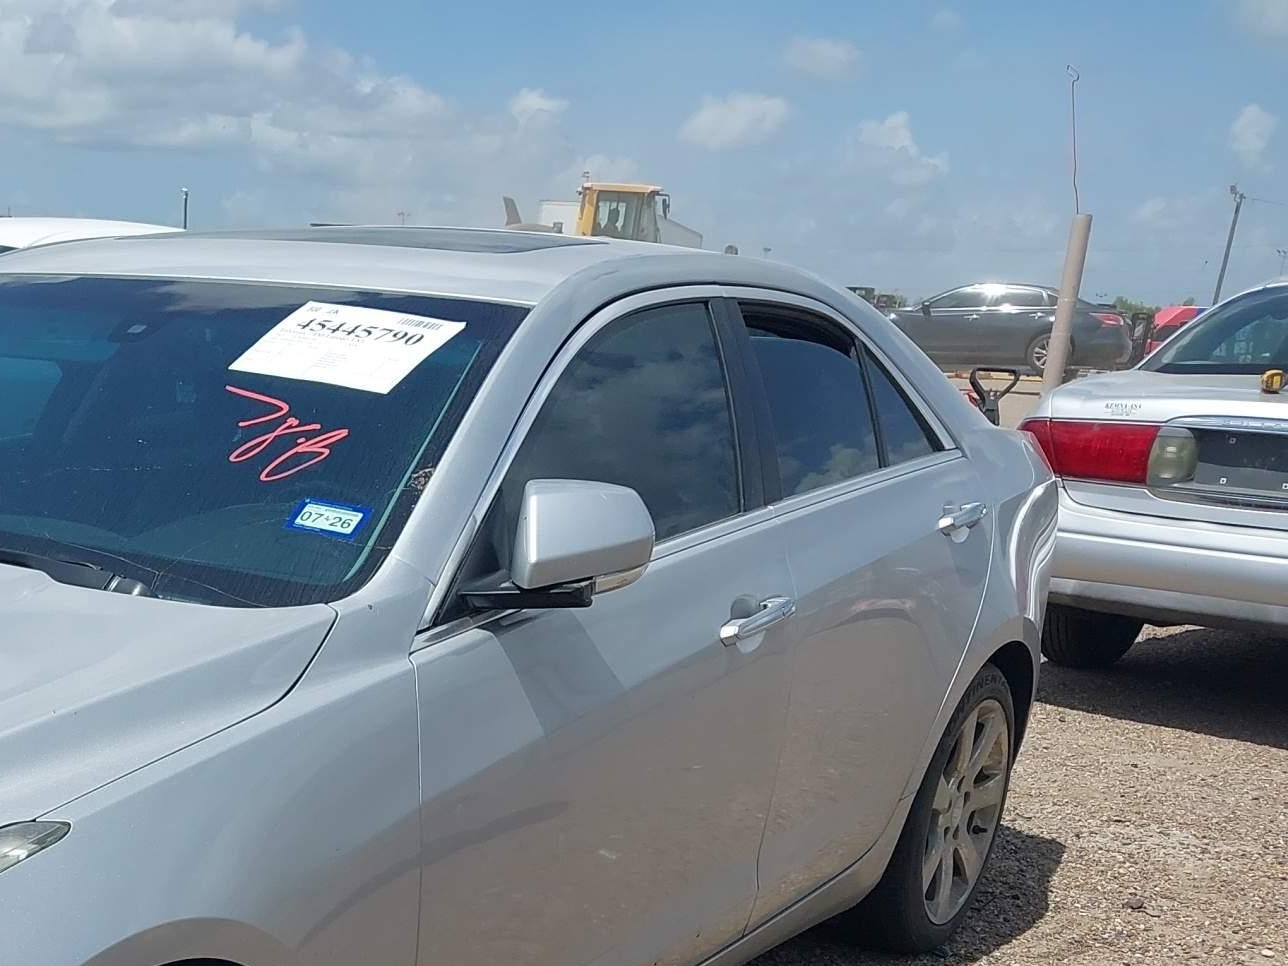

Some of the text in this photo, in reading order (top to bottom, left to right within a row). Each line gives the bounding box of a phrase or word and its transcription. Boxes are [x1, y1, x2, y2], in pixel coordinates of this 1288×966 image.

[295, 317, 425, 347] 45445790
[300, 510, 324, 524] 07
[328, 516, 354, 529] 26
